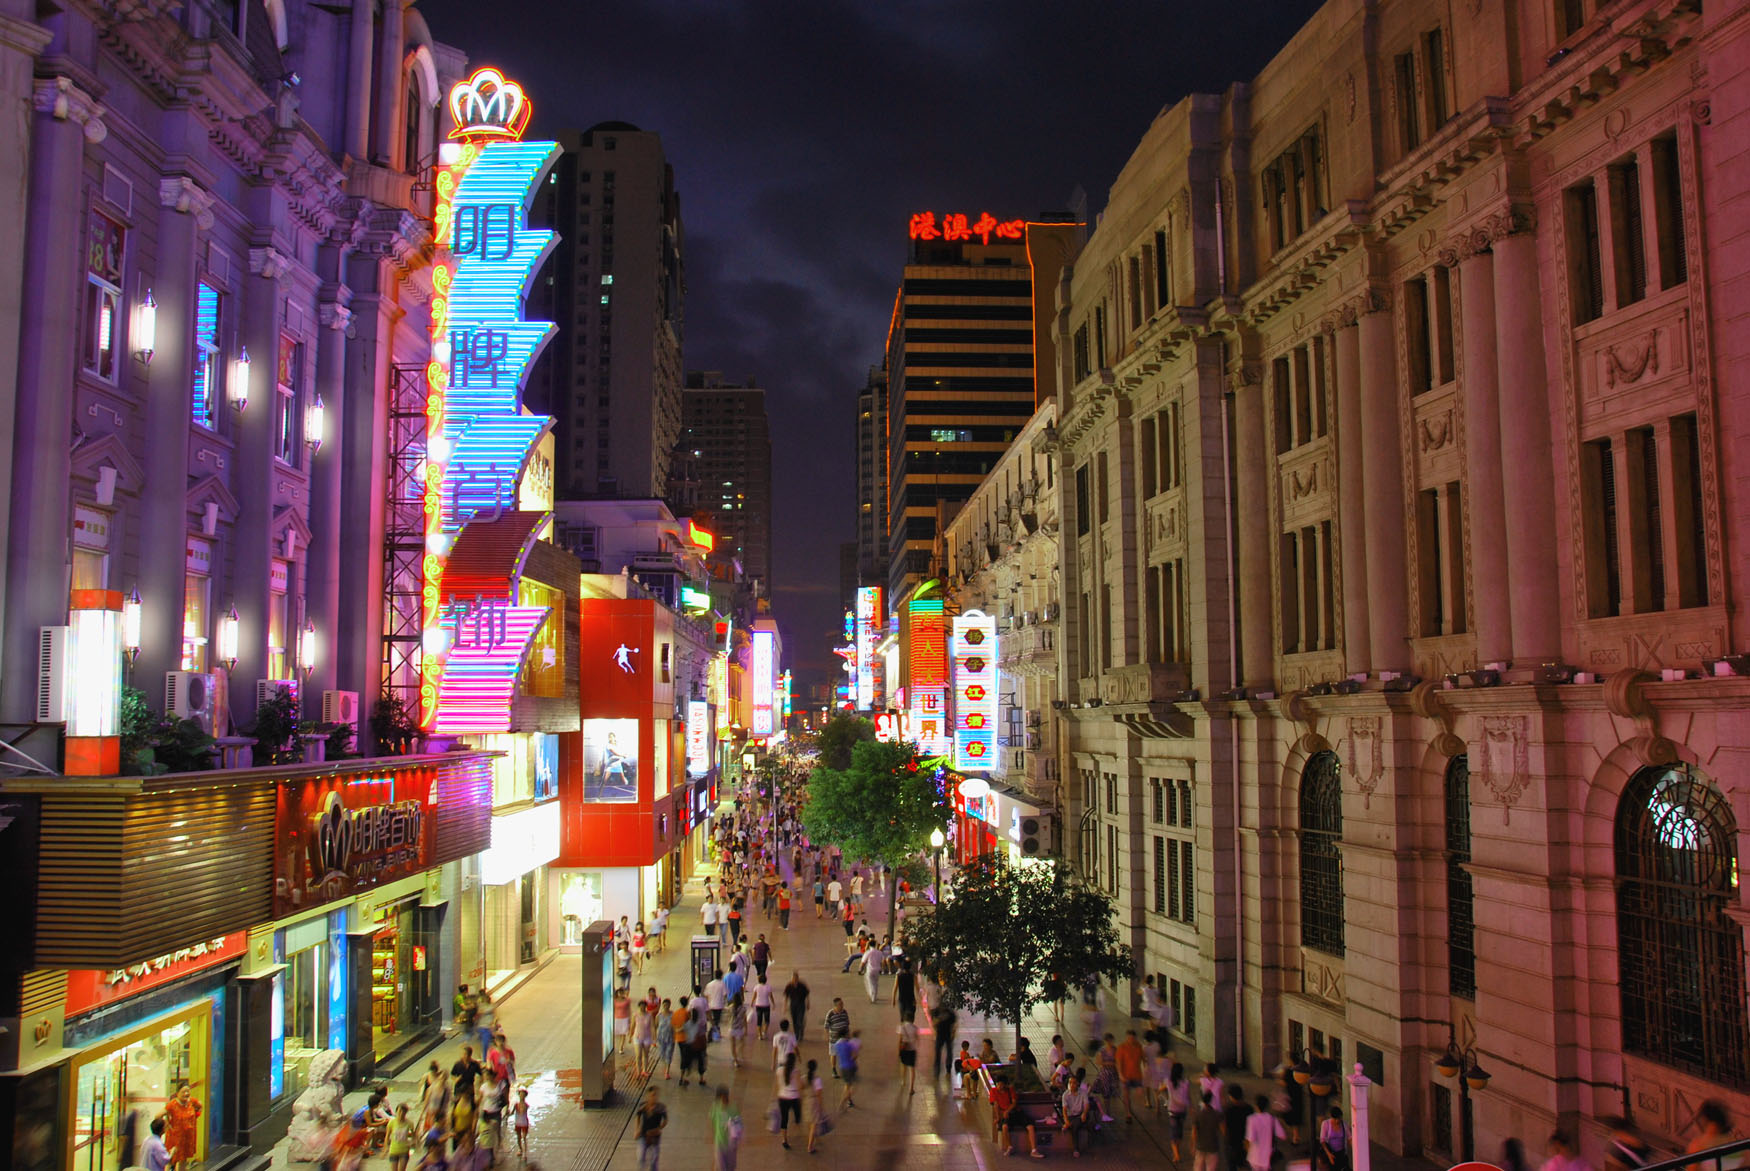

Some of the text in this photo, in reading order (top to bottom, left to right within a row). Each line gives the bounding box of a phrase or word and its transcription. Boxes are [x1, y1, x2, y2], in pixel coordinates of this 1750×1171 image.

[910, 212, 1025, 245] 港澳中心
[446, 204, 515, 655] 明牌首饰
[967, 632, 984, 755] 扬子江酒店
[353, 802, 421, 855] 明牌首饰
